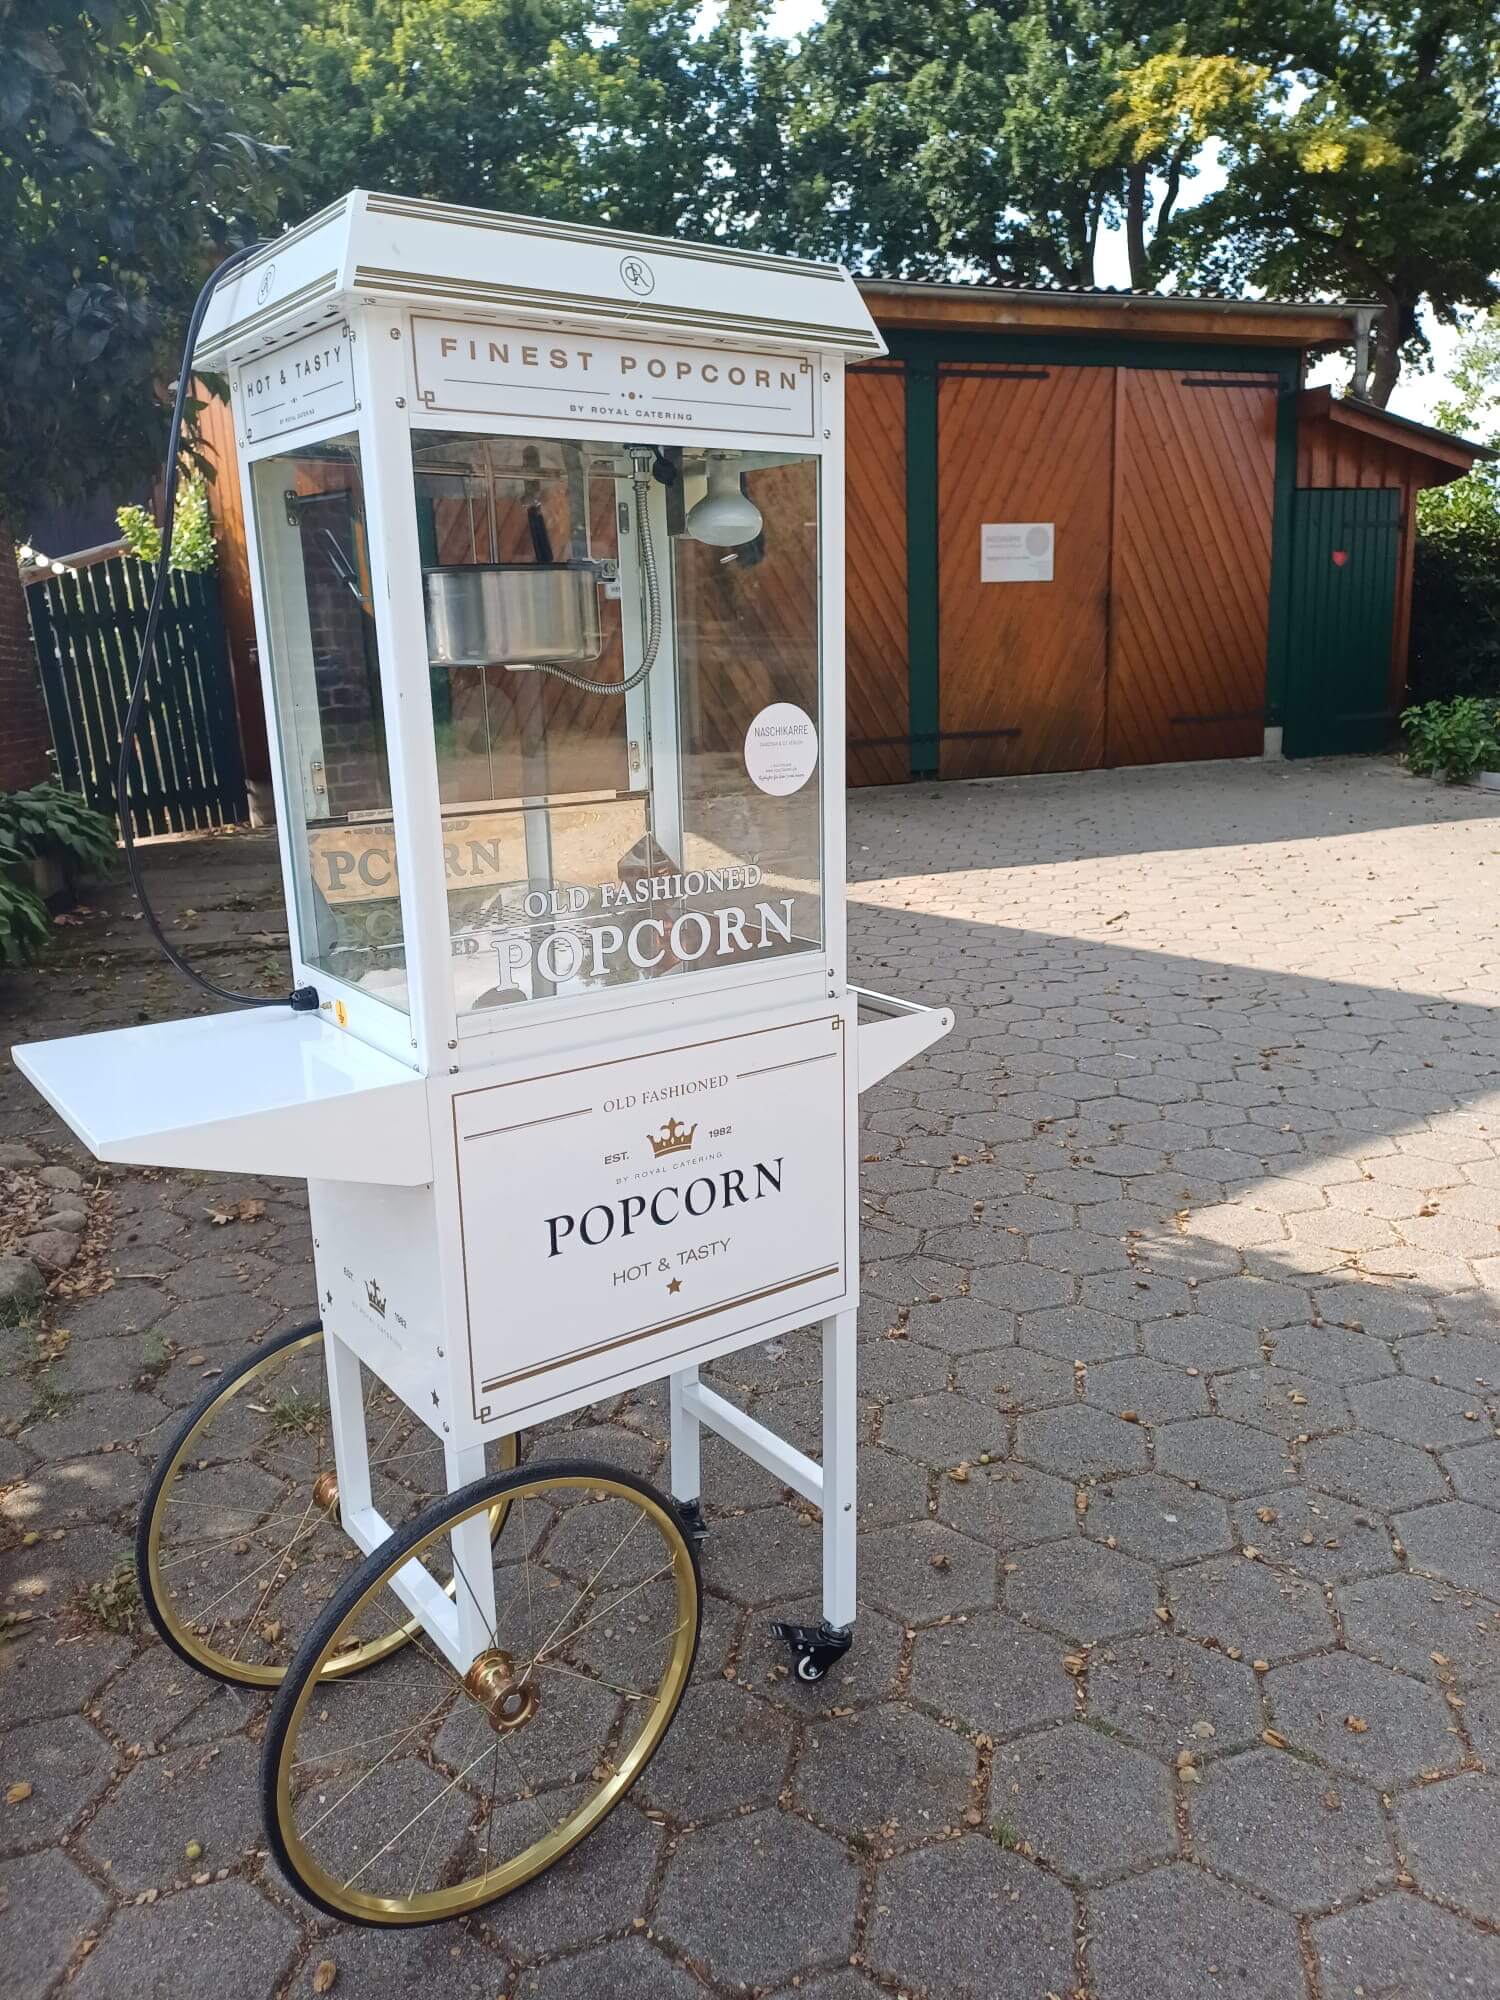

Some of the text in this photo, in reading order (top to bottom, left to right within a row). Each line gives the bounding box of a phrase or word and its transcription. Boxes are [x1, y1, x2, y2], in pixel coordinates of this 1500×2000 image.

[247, 346, 342, 398] HOT & TASTY
[440, 337, 796, 390] FINEST POPCORN
[569, 404, 693, 421] BY ROYAL CATERING
[754, 724, 809, 737] NASCHIKARRE
[523, 863, 763, 919] OLD FASHIONED
[491, 898, 796, 993] POPCORN
[603, 1074, 729, 1113] OLD FASHIONED
[604, 1125, 733, 1165] EST. 1982
[616, 1151, 723, 1185] BY ROYAL CATERING
[544, 1157, 785, 1259] POPCORN
[613, 1237, 732, 1287] HOT & TASTY
